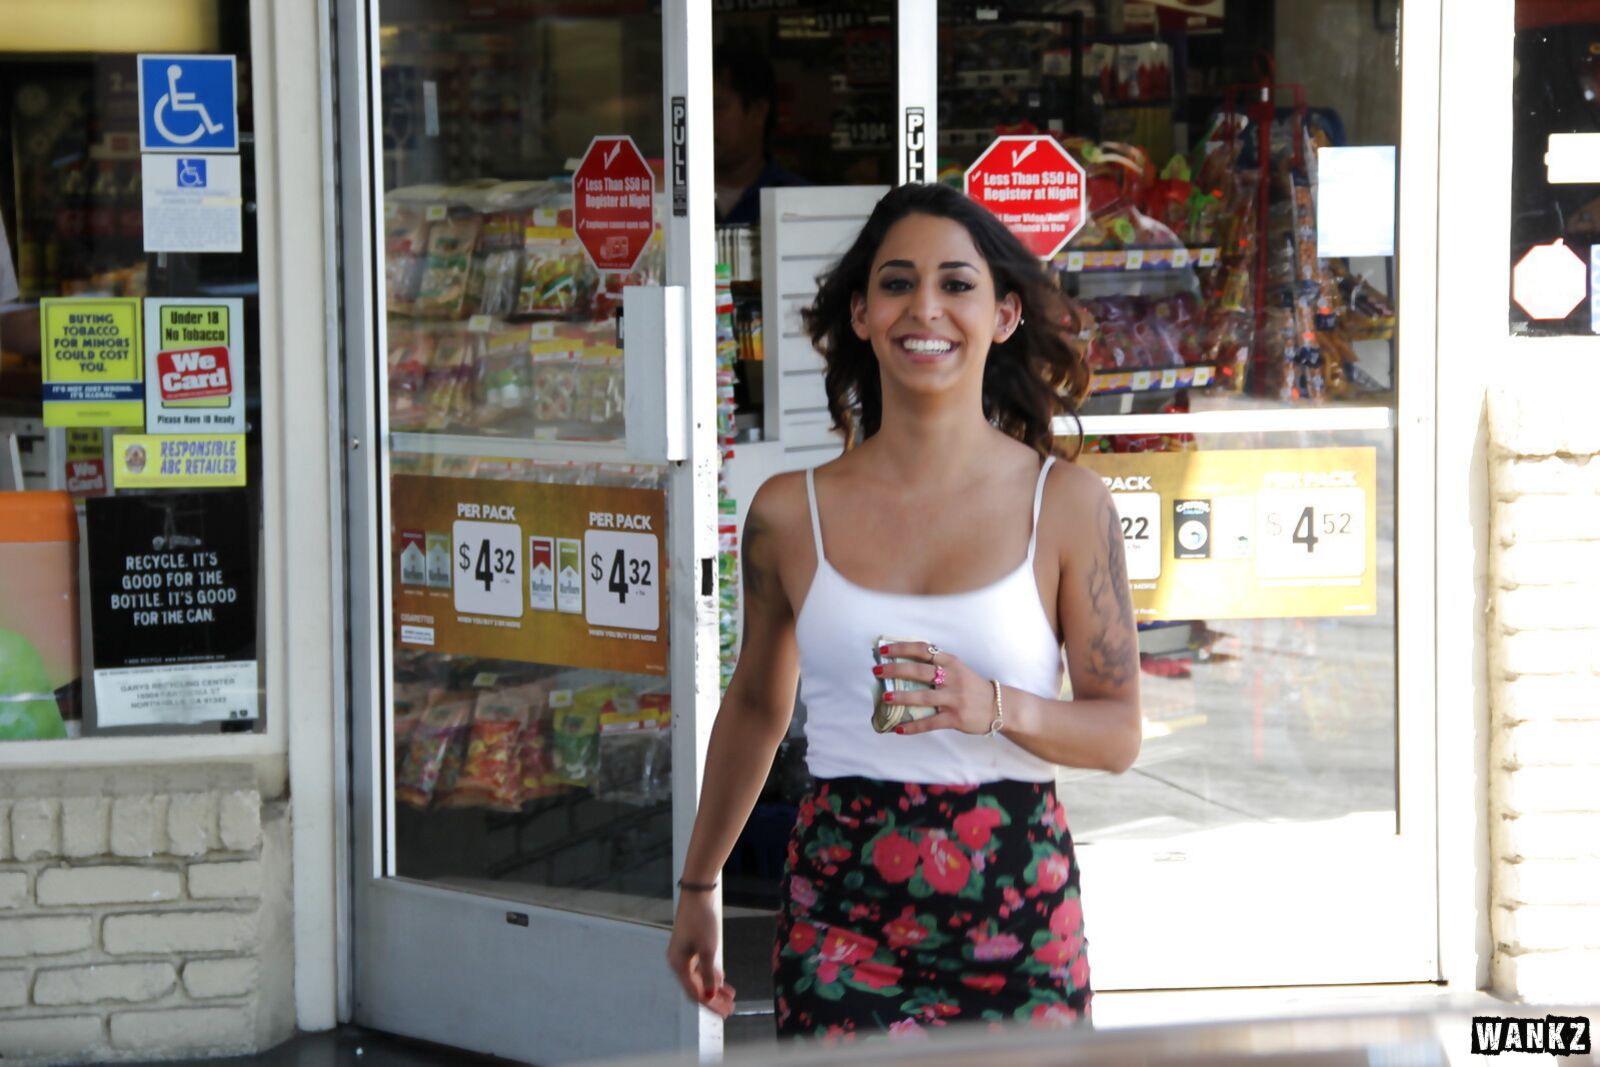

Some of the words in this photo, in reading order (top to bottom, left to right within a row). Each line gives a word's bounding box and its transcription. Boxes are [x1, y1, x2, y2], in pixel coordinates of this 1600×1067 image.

[674, 106, 685, 185] PULL
[585, 178, 603, 191] Less
[604, 178, 623, 192] Than
[624, 178, 640, 191] $50
[984, 172, 1009, 186] Less
[1012, 172, 1040, 186] Than
[1041, 171, 1063, 186] $50
[585, 194, 618, 208] Register
[619, 195, 628, 207] at
[629, 194, 650, 209] Night
[984, 187, 1032, 202] Register
[1034, 188, 1045, 200] at
[1047, 187, 1078, 202] Night
[69, 314, 114, 324] BUYING
[170, 311, 203, 324] Under
[207, 311, 219, 324] 18
[63, 326, 119, 336] TOBACCO
[165, 328, 180, 341] No
[182, 328, 225, 341] Tobacco
[54, 338, 78, 348] FOR
[82, 338, 130, 348] MINORS
[55, 350, 95, 360] COULD
[99, 350, 129, 360] COST
[170, 351, 217, 373] We
[79, 362, 107, 373] YOU.
[162, 367, 228, 392] Card
[160, 440, 237, 458] RESPONSIBLE
[160, 459, 182, 475] ABC
[185, 458, 237, 474] RETAILER
[457, 503, 481, 518] PER
[483, 504, 516, 521] PACK
[589, 512, 613, 528] PER
[616, 513, 652, 530] PACK
[126, 553, 188, 570] RECYCLE.
[193, 552, 218, 567] IT'S
[122, 573, 162, 590] GOOD
[166, 572, 193, 587] FOR
[198, 570, 223, 585] THE
[111, 592, 164, 609] BOTTLE.
[168, 591, 193, 605] IT'S
[197, 588, 236, 604] GOOD
[133, 611, 158, 626] FOR
[162, 610, 184, 624] THE
[186, 608, 215, 623] CAN.
